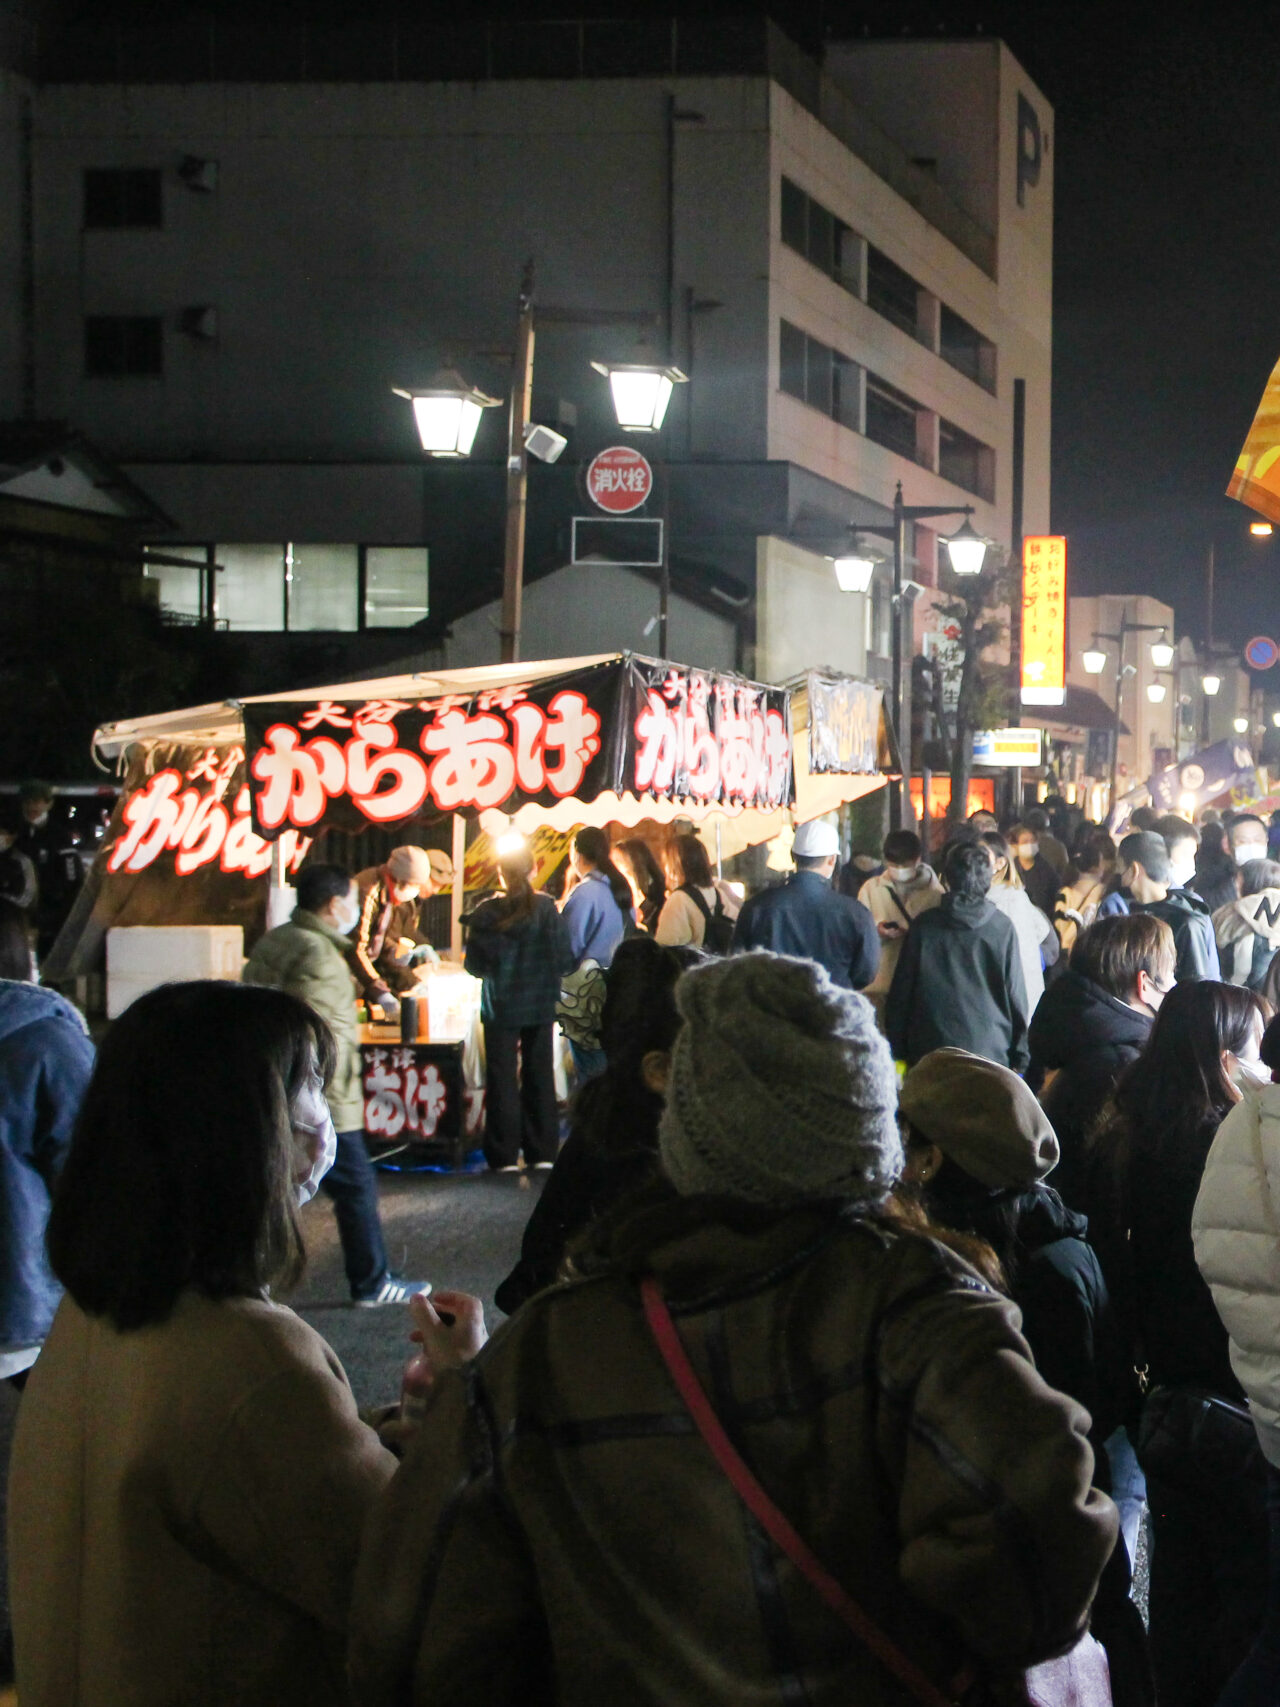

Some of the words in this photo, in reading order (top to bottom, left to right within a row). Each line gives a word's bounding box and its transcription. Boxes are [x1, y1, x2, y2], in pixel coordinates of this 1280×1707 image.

[594, 467, 647, 492] 消火栓
[252, 690, 601, 829] からあげ
[634, 688, 790, 801] からあげ
[364, 1064, 447, 1137] あげ
